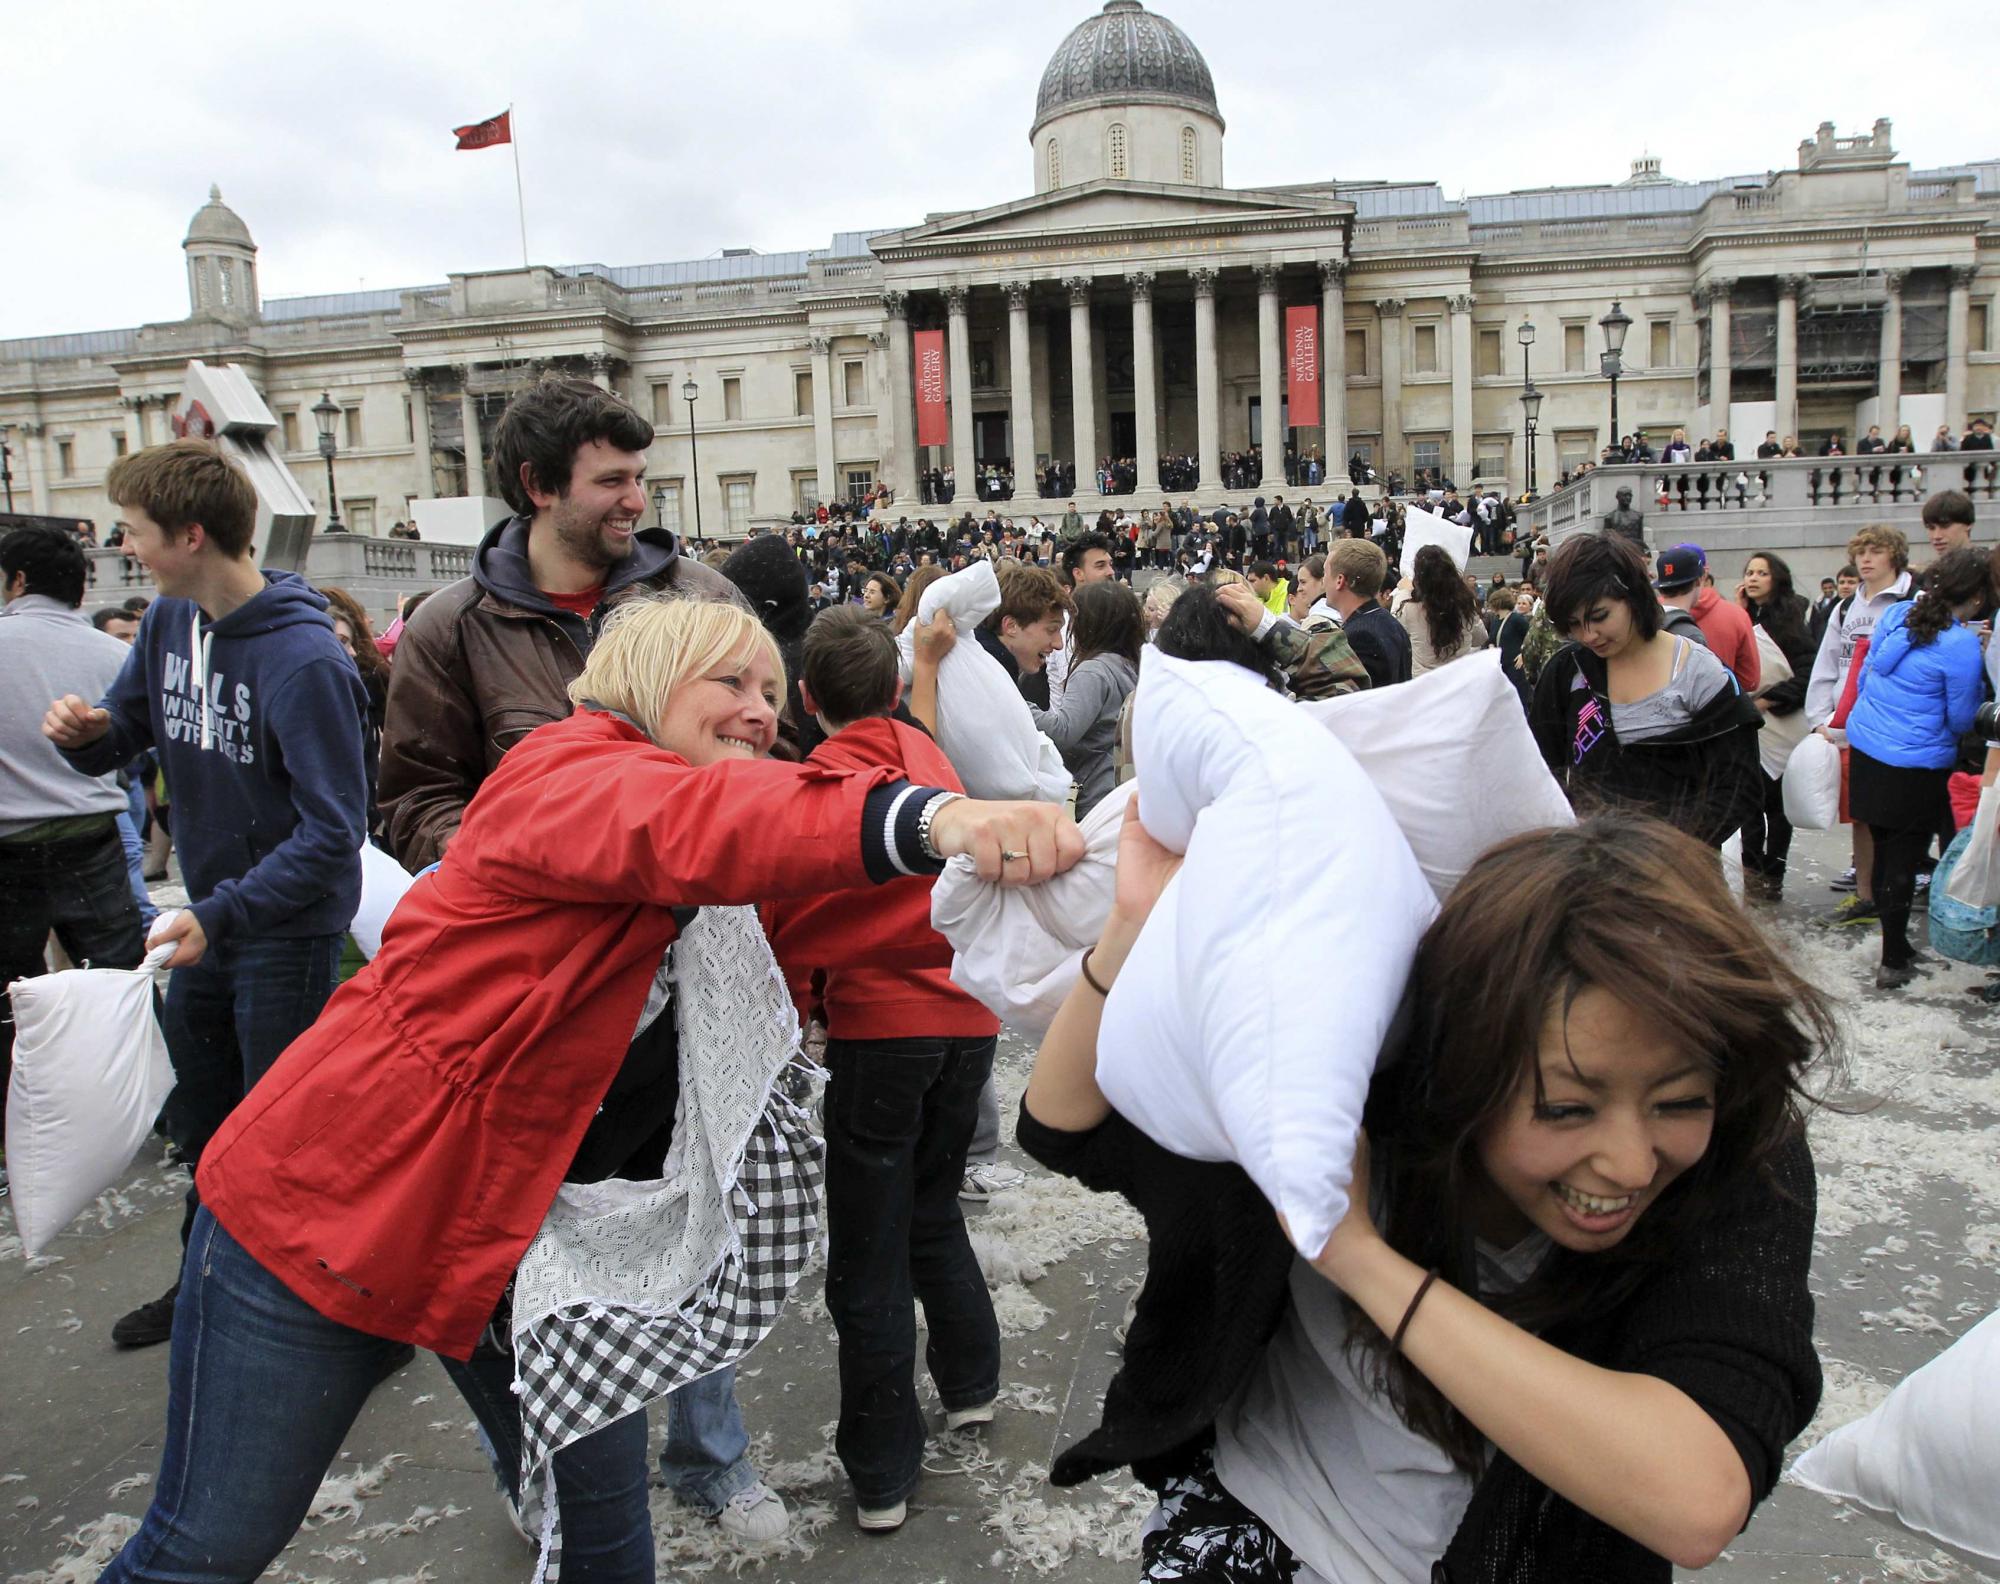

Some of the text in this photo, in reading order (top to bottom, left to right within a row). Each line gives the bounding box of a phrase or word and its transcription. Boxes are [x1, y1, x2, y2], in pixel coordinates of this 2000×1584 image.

[923, 351, 932, 402] NATIONAL
[931, 348, 941, 402] GALLERY
[1295, 326, 1304, 381] NATIONAL
[1304, 326, 1314, 381] GALLERY
[164, 652, 250, 722] WLS
[163, 693, 249, 742] NIVEITY
[165, 716, 254, 764] UTFTTRS
